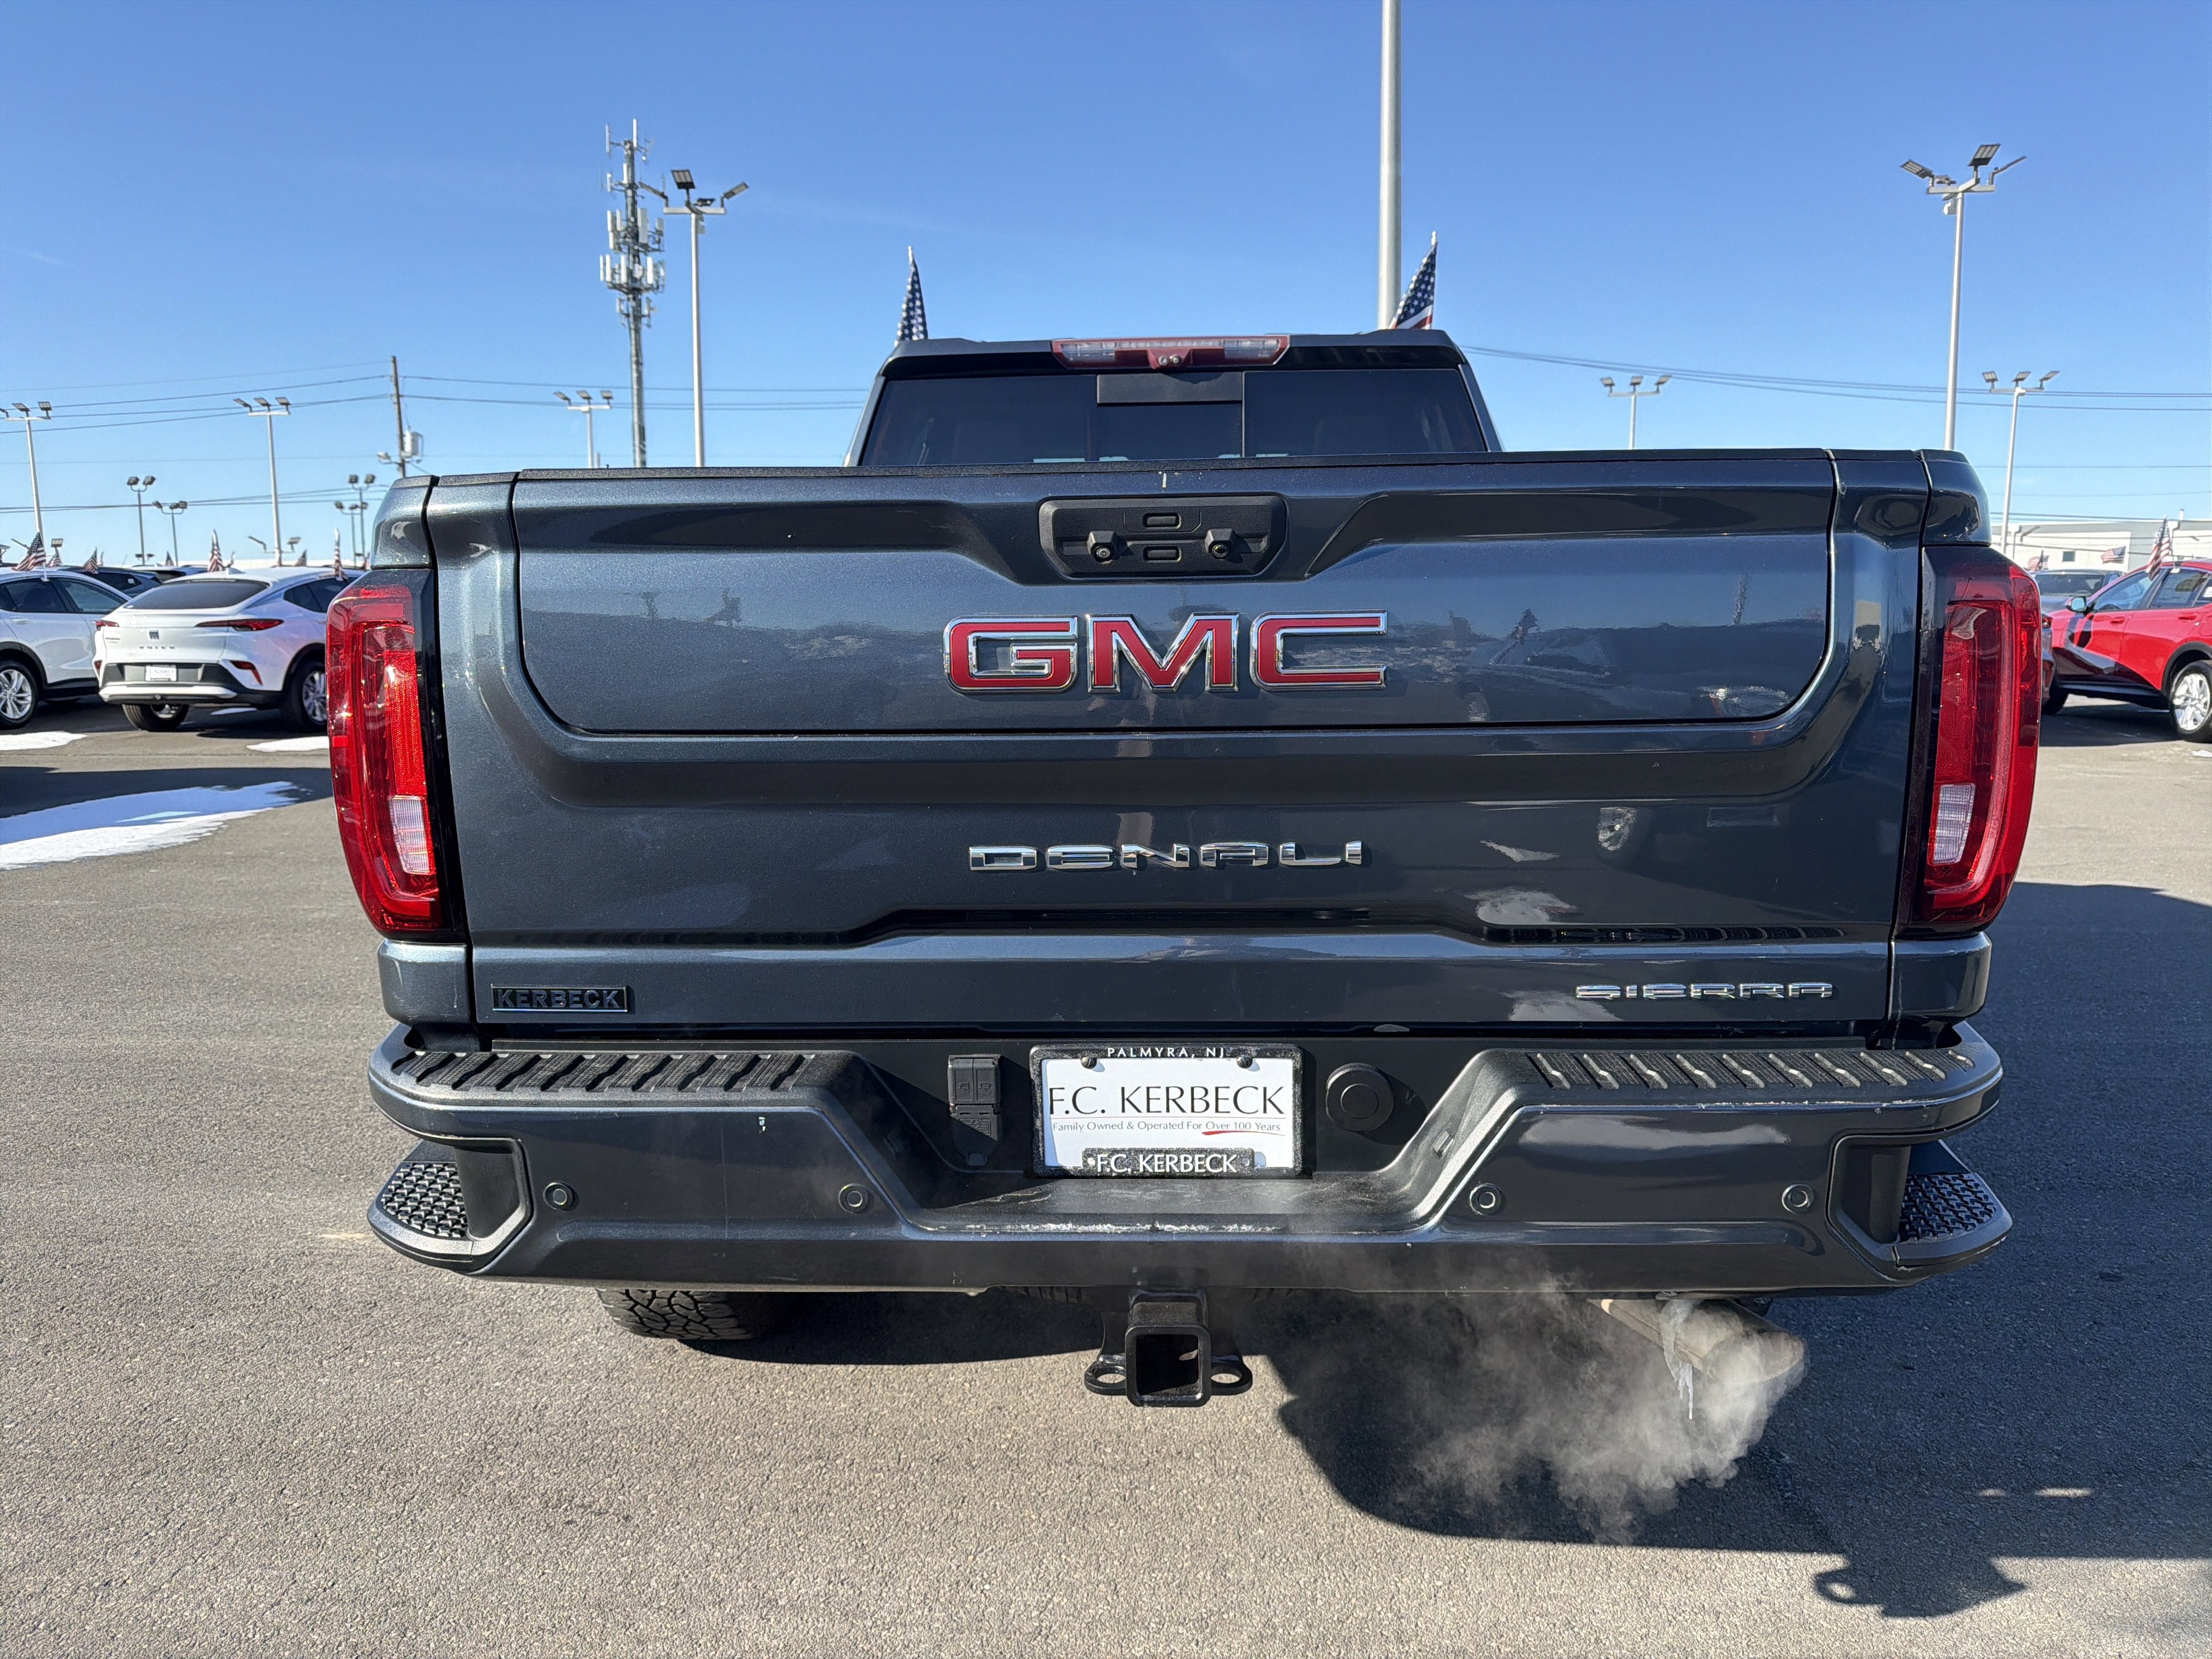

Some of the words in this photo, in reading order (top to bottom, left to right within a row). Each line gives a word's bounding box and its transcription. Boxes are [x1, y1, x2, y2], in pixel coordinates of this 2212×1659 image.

[943, 610, 1388, 693] GMC
[969, 840, 1363, 871] DENALI
[497, 989, 620, 1008] KERBECK
[1576, 982, 1833, 999] SIERRA
[1107, 1047, 1195, 1059] PALMYRA,
[1206, 1047, 1224, 1059] NJ
[1049, 1086, 1106, 1115] F.C.
[1121, 1086, 1285, 1115] KERBECK
[1053, 1122, 1084, 1132] Family
[1087, 1121, 1123, 1130] Owned
[1126, 1121, 1134, 1130] &
[1137, 1121, 1184, 1131] Operated
[1187, 1121, 1203, 1130] For
[1206, 1121, 1230, 1130] Over
[1234, 1122, 1251, 1130] 100
[1255, 1122, 1280, 1131] Years
[1097, 1154, 1132, 1173] F.C.
[1139, 1154, 1237, 1173] KERBECK
